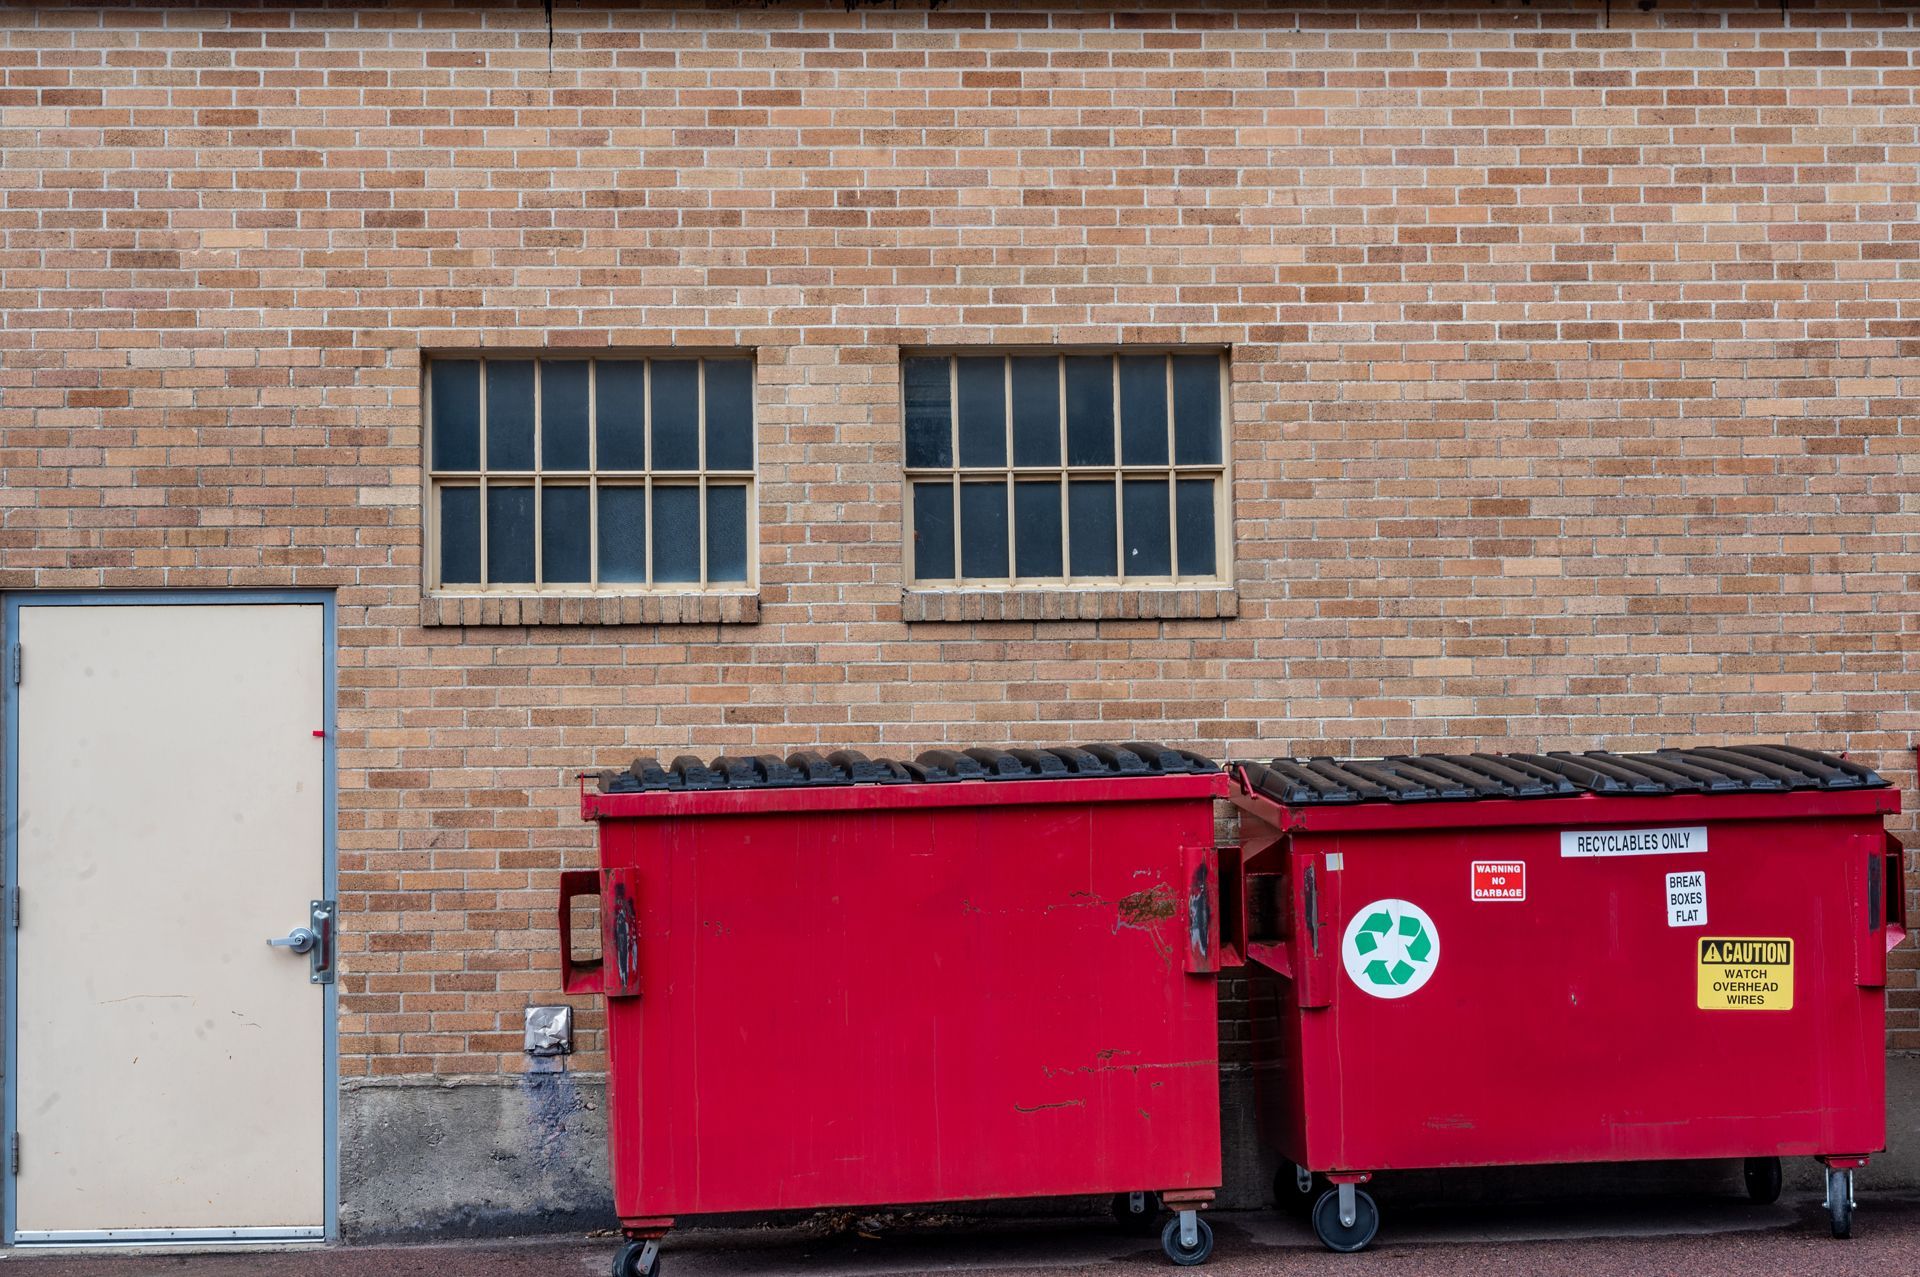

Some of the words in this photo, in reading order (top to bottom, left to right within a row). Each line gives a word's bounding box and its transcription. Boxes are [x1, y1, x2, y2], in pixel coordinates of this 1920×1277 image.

[1577, 833, 1658, 852] RECYCLABLES
[1662, 832, 1691, 850] ONLY
[1476, 865, 1521, 873] WARNING
[1491, 877, 1506, 885] NO
[1669, 875, 1702, 888] BREAK
[1475, 889, 1522, 897] GARBAGE
[1670, 892, 1702, 905] BOXES
[1676, 909, 1699, 922] FLAT
[1722, 942, 1787, 963] CAUTION
[1724, 969, 1767, 979] WATCH
[1713, 982, 1779, 992] OVERHEAD
[1726, 995, 1765, 1005] WIRES
